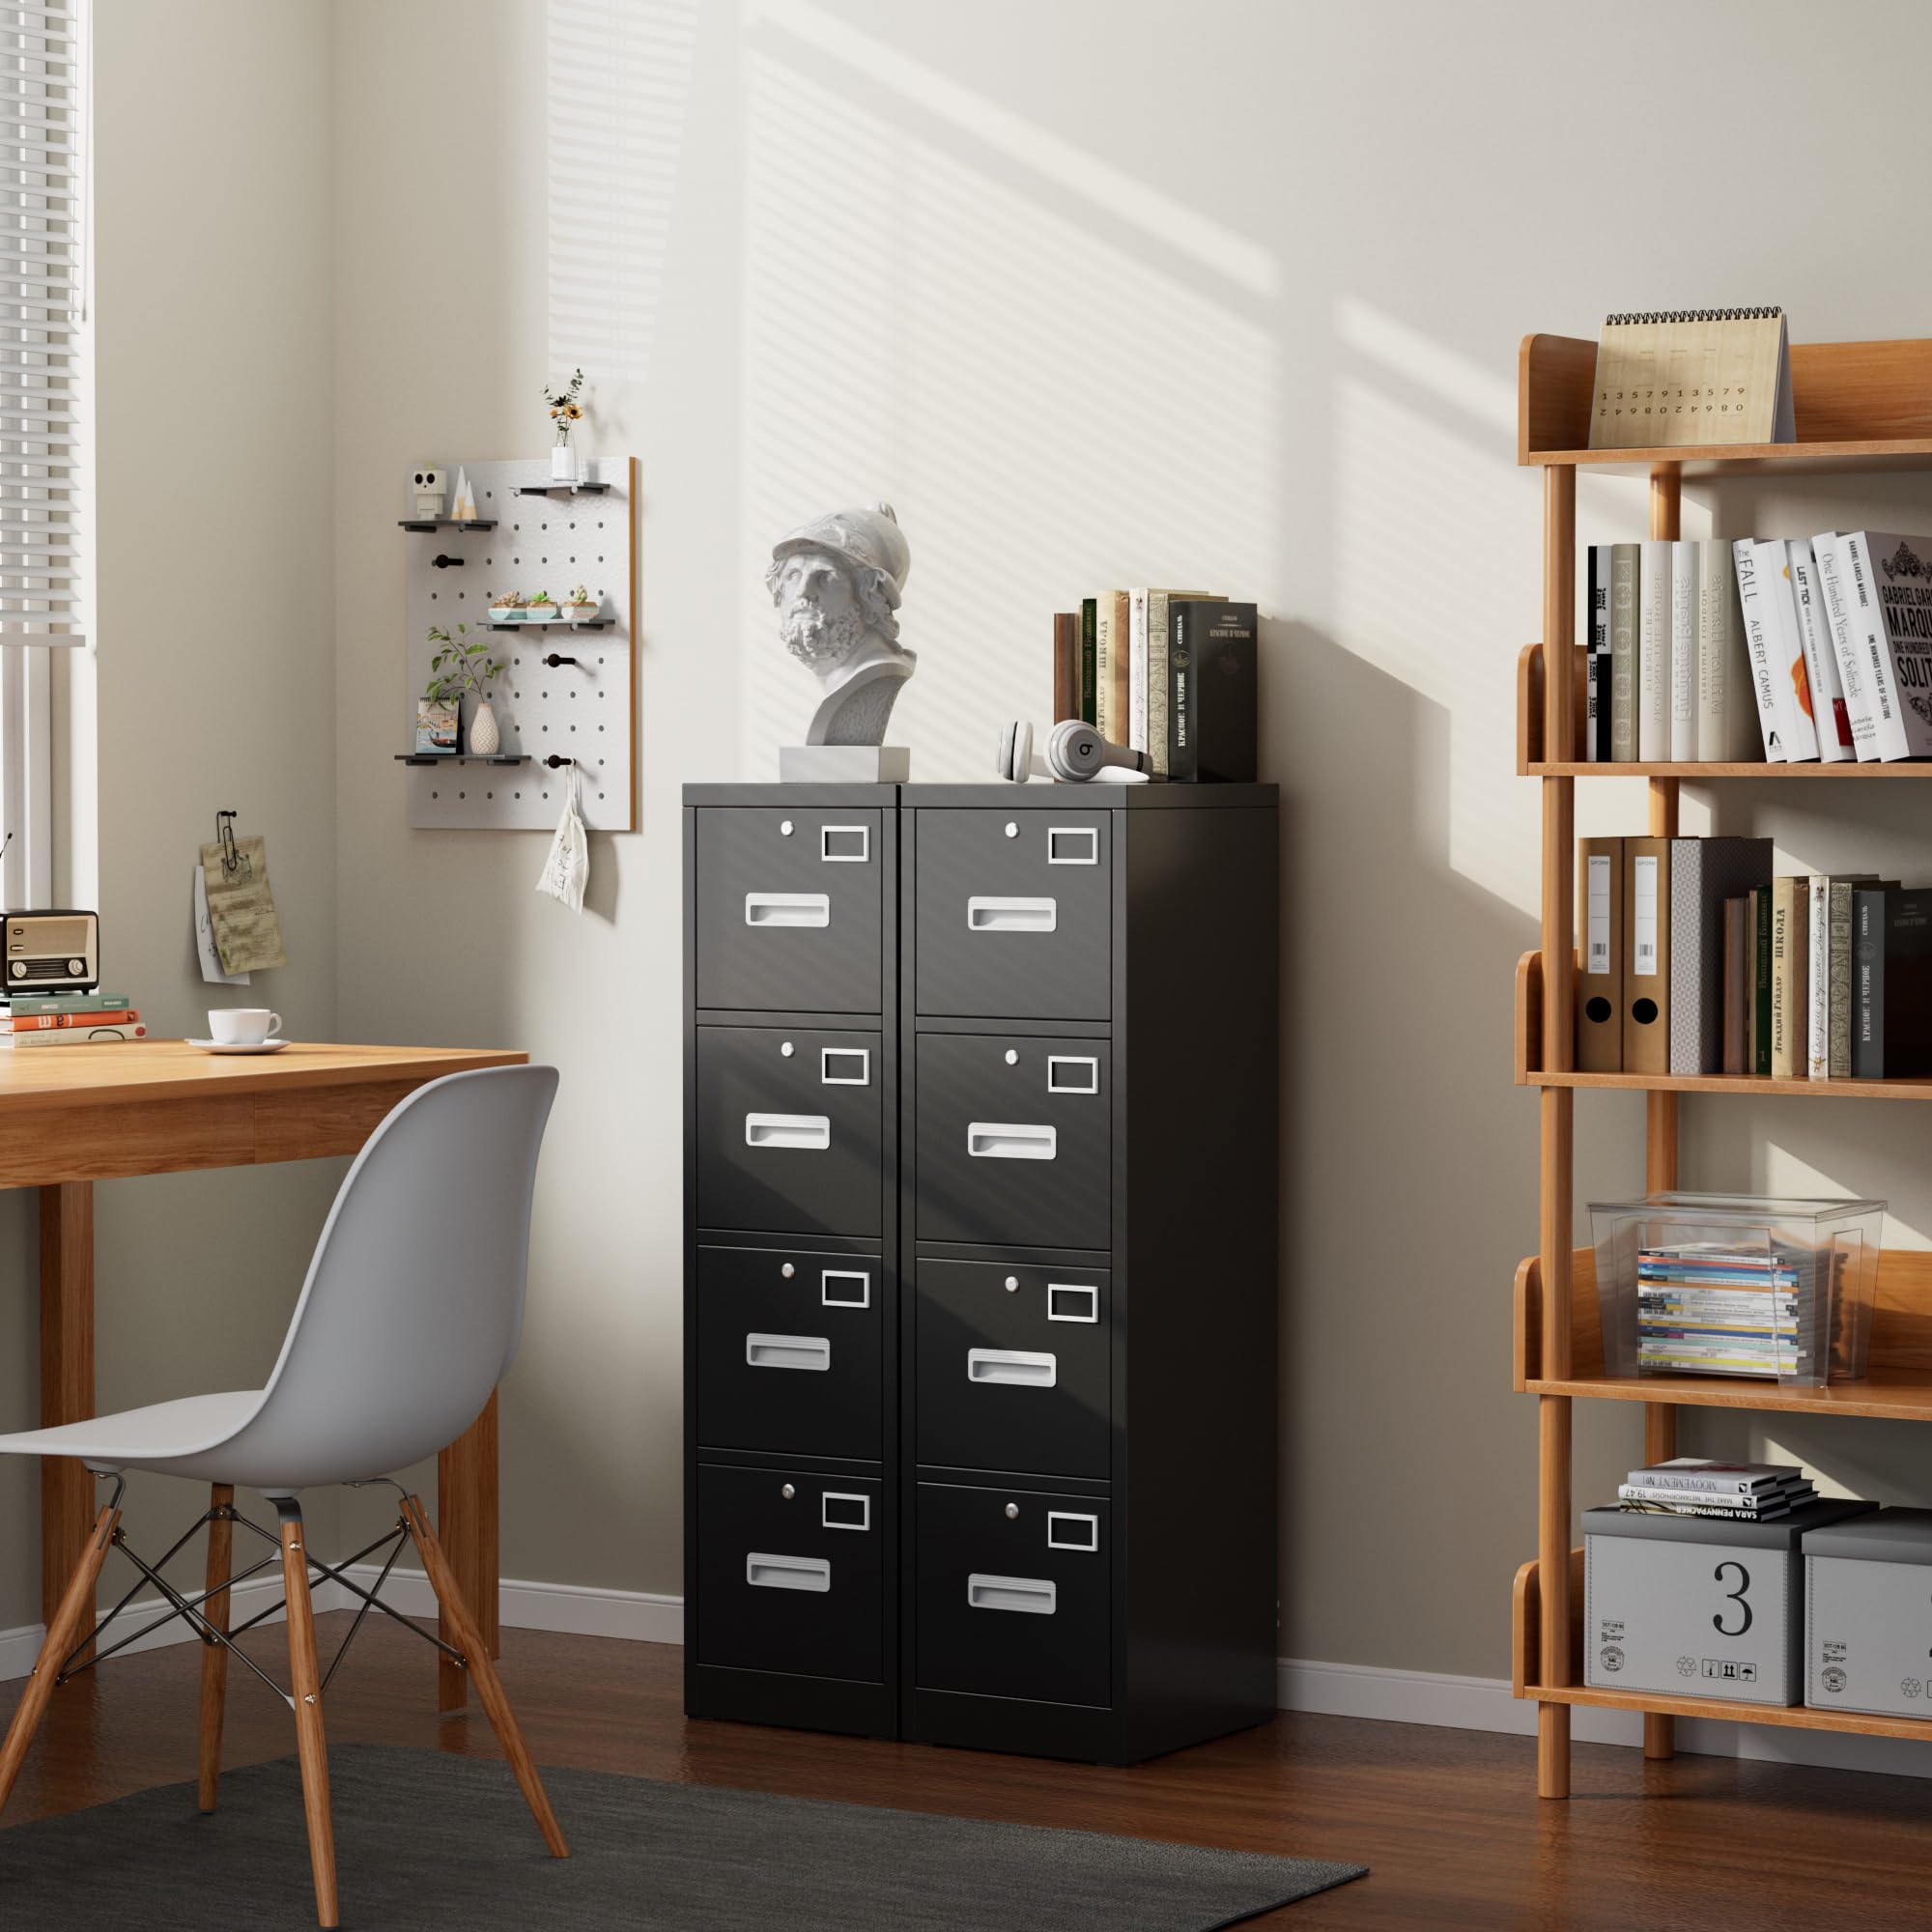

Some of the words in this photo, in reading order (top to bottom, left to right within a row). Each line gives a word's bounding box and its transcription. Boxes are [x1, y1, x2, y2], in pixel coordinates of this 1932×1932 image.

[1848, 540, 1860, 562] GABRIEL
[1796, 565, 1807, 586] LAST
[1821, 553, 1835, 575] One
[1738, 558, 1759, 604] FALL
[1800, 588, 1810, 606] TICK
[1826, 576, 1846, 618] Hundred
[1882, 585, 1917, 606] GABRIEL
[1916, 588, 1932, 608] GAR
[1749, 619, 1767, 666] ALBERT
[1834, 619, 1851, 645] Years
[1867, 634, 1876, 644] ONE
[1840, 646, 1854, 659] of
[1868, 644, 1883, 669] HUNDRED
[1893, 641, 1904, 653] ONE
[1905, 641, 1930, 654] HUNDRED
[1757, 668, 1775, 710] CAMUS
[1843, 659, 1862, 698] Solitude
[1873, 669, 1886, 687] YEARS
[1878, 687, 1887, 696] OF
[1878, 695, 1892, 720] SOLITUDE
[1178, 713, 1186, 747] КРАСНОЕ
[1775, 908, 1785, 958] ШКОЛА
[1861, 965, 1870, 996] ЧЕРНОЕ
[1862, 1007, 1871, 1041] КРАСНОЕ
[1659, 1476, 1716, 1491] MOOVEMENT
[1676, 1506, 1733, 1517] PENNYPACKER
[1735, 1509, 1757, 1519] SARA
[1713, 1561, 1752, 1636] 3
